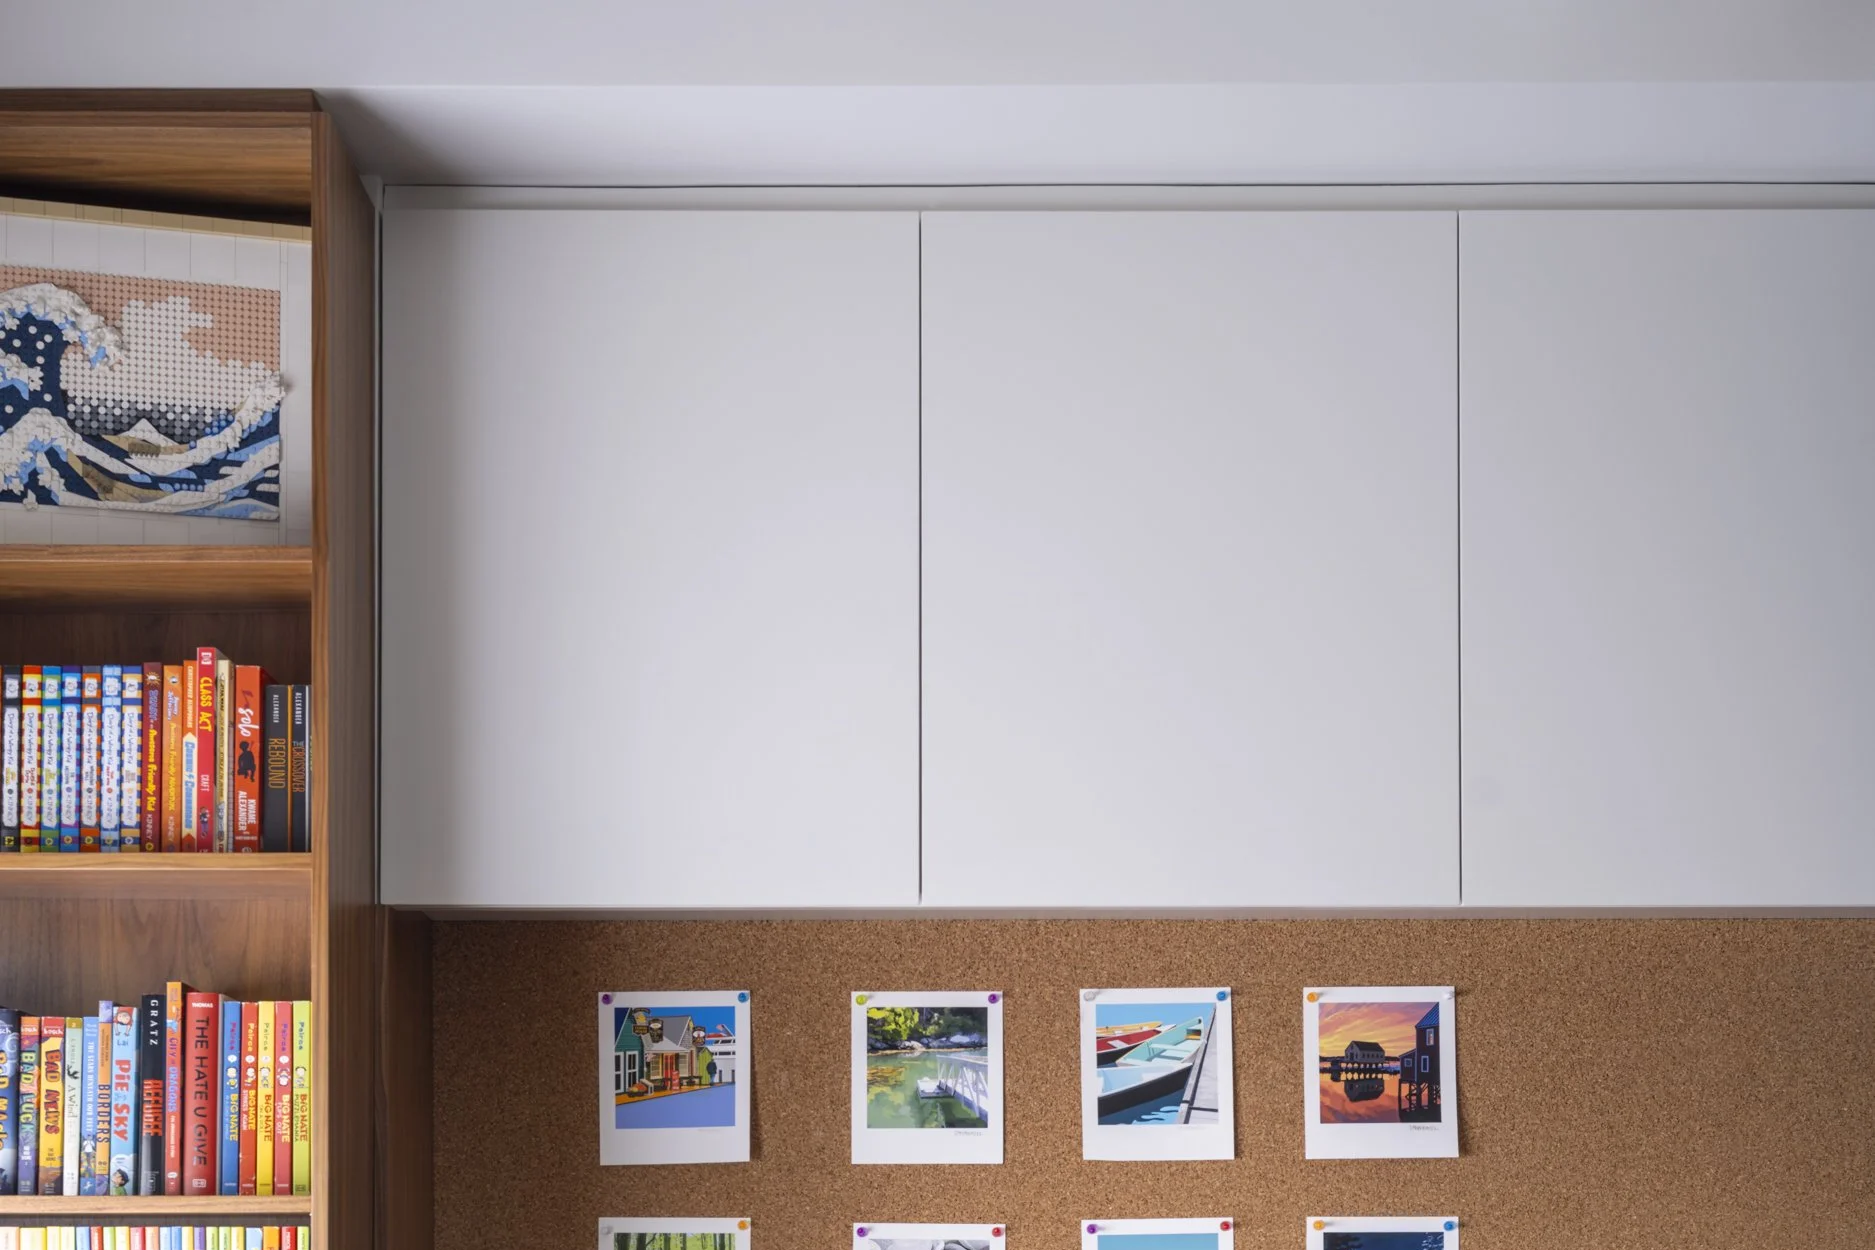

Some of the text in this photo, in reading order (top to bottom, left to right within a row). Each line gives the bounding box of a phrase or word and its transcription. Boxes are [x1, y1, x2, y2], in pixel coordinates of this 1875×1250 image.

[200, 677, 212, 708] CLASS
[199, 712, 212, 732] ACT
[272, 694, 280, 724] ALEXANDER
[148, 729, 157, 763] Awesome
[268, 738, 286, 789] REBOUND
[292, 746, 306, 792] CROSSOVER
[145, 764, 156, 795] Friendly
[200, 774, 210, 792] CRAFT
[146, 796, 156, 812] Kid
[238, 791, 248, 831] ALEXANDER
[247, 799, 256, 824] KWAME
[145, 814, 153, 840] KINNEY
[150, 1000, 158, 1046] GRATZ
[262, 1022, 270, 1051] Peirce
[20, 1051, 36, 1134] BAD LUCK
[44, 1049, 62, 1134] BAD NEWS
[68, 1084, 76, 1092] A
[167, 1066, 178, 1112] DRAGONS
[193, 1016, 210, 1166] THE HATE U GIVE
[67, 1094, 78, 1118] Wind
[96, 1084, 110, 1143] BORDERS
[248, 1106, 256, 1130] NATE
[230, 1114, 238, 1142] NATE
[264, 1116, 272, 1142] NATE
[282, 1116, 290, 1143] NATE
[300, 1115, 308, 1142] NATE
